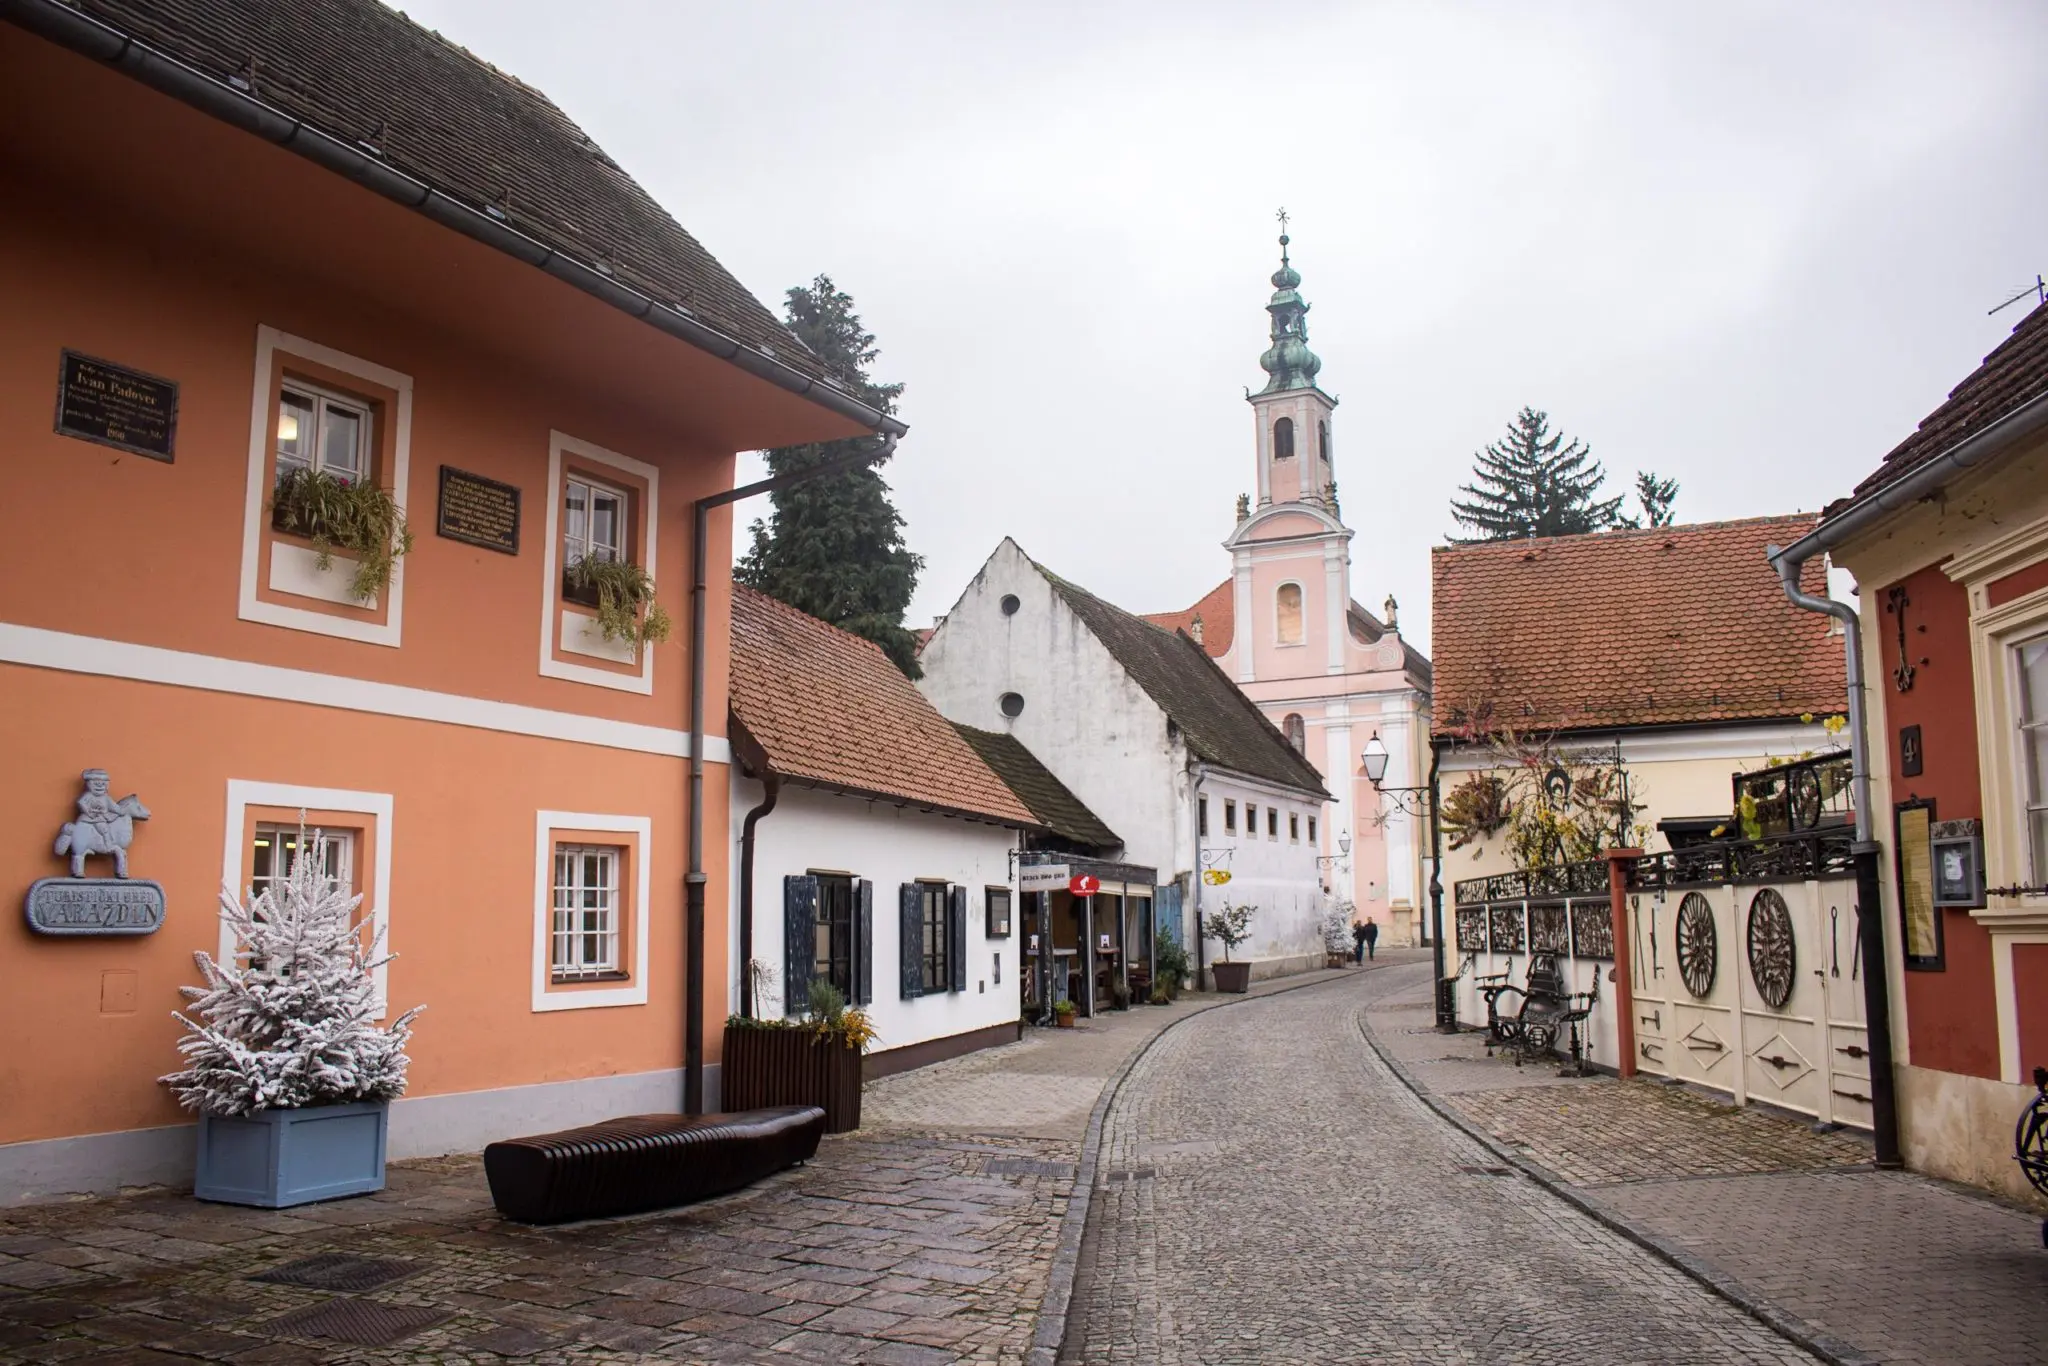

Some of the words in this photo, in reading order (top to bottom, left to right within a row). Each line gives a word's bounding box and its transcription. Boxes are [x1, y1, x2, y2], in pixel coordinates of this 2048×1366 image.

[77, 371, 105, 390] Ivan
[111, 381, 157, 405] Padovec
[1904, 736, 1914, 761] 4
[38, 902, 159, 927] VARAŽDIN
